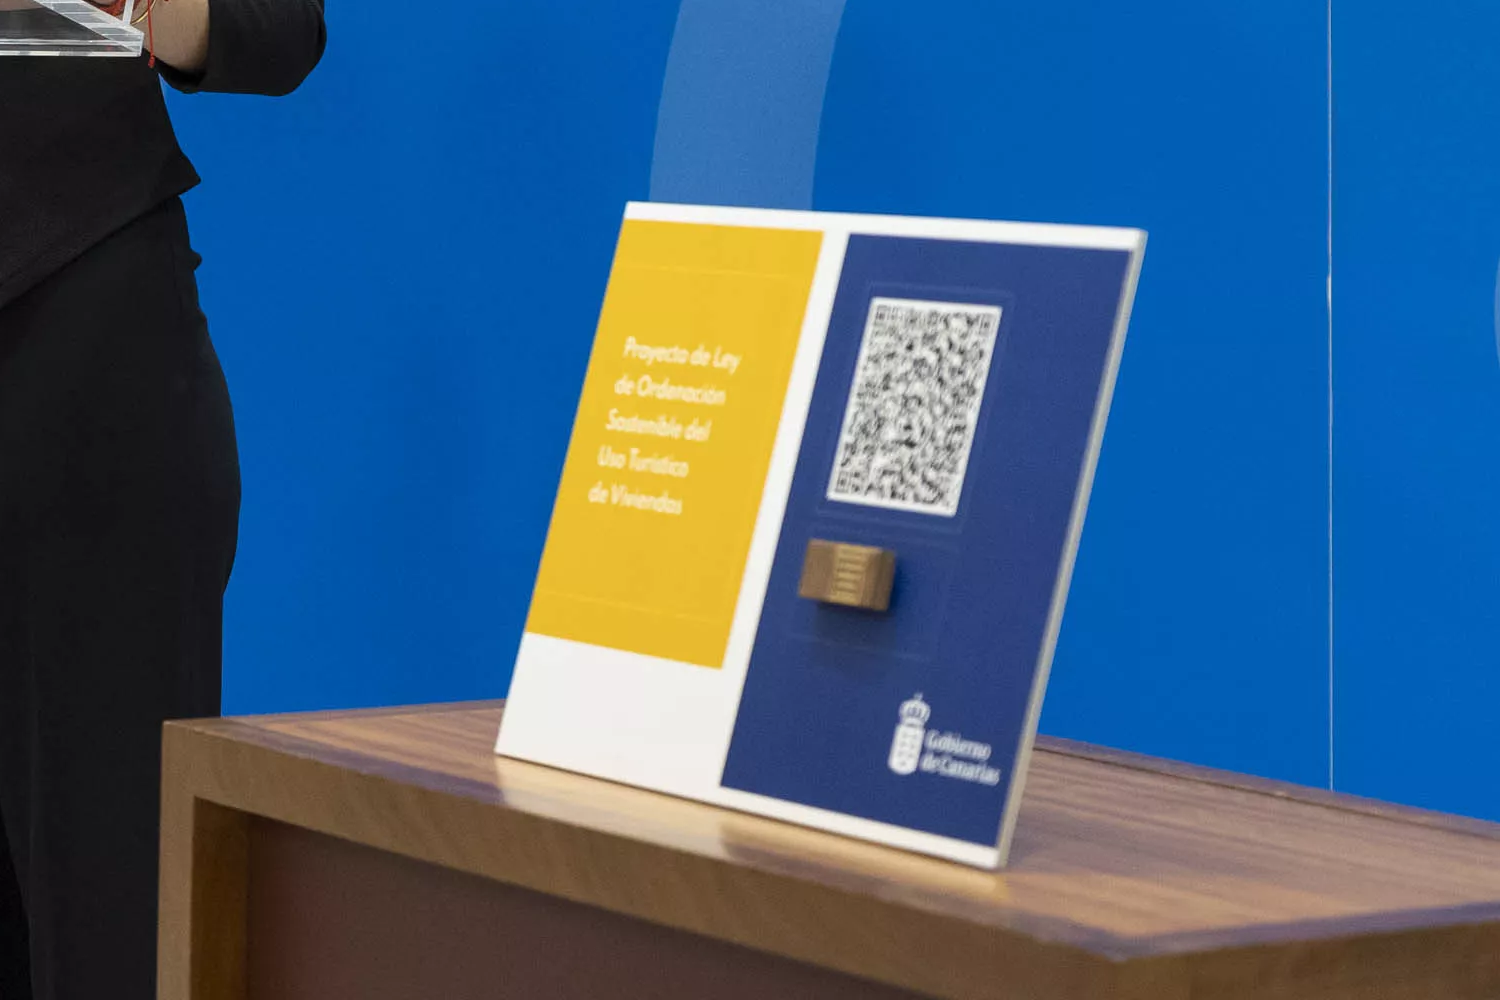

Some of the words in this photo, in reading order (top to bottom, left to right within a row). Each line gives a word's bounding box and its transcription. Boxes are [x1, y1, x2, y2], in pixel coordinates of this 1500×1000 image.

[623, 335, 690, 366] Proyecto
[689, 344, 711, 367] de
[713, 346, 743, 375] Ley
[614, 373, 635, 396] de
[683, 418, 712, 442] del
[597, 445, 626, 469] Uso
[587, 481, 610, 503] de
